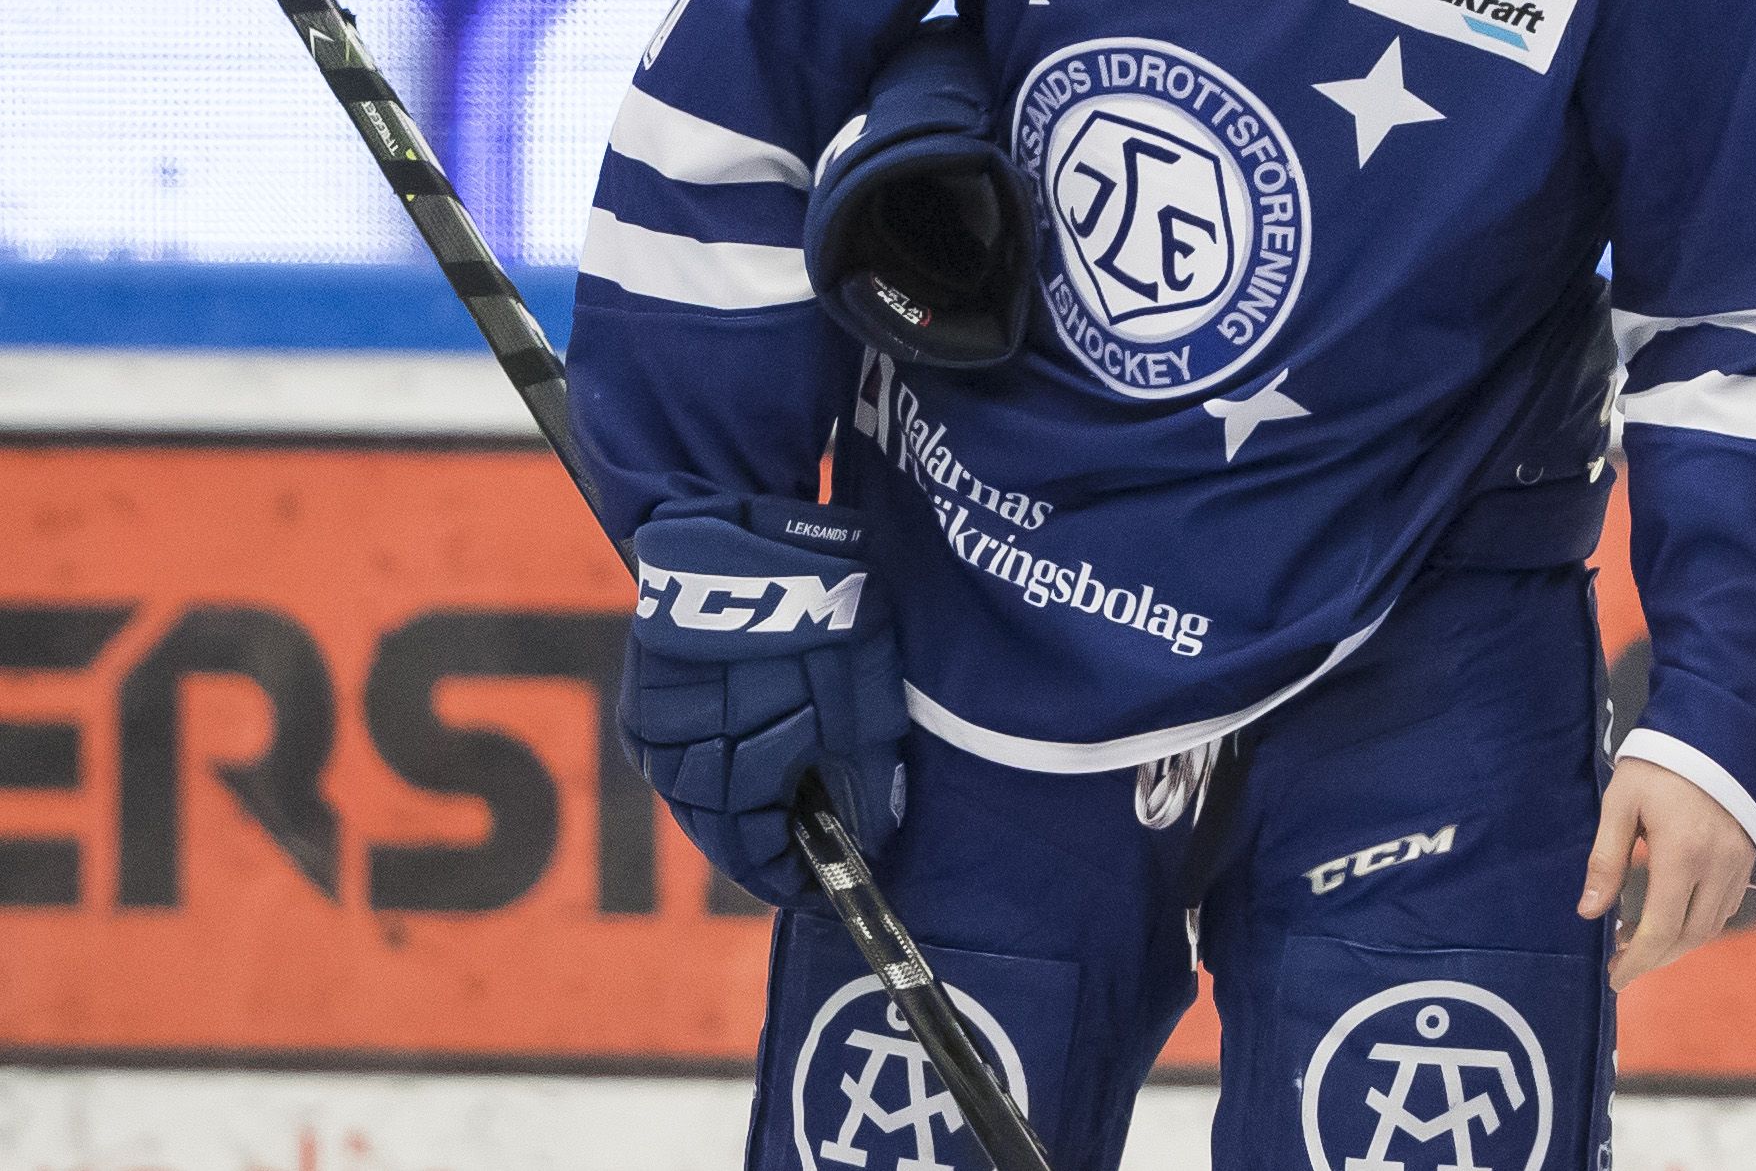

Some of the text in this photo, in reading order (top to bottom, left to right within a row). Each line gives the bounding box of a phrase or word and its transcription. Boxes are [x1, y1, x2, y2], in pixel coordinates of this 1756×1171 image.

[785, 519, 848, 542] LEKSANDS
[636, 562, 868, 632] CCM
[1304, 824, 1458, 897] CCM
